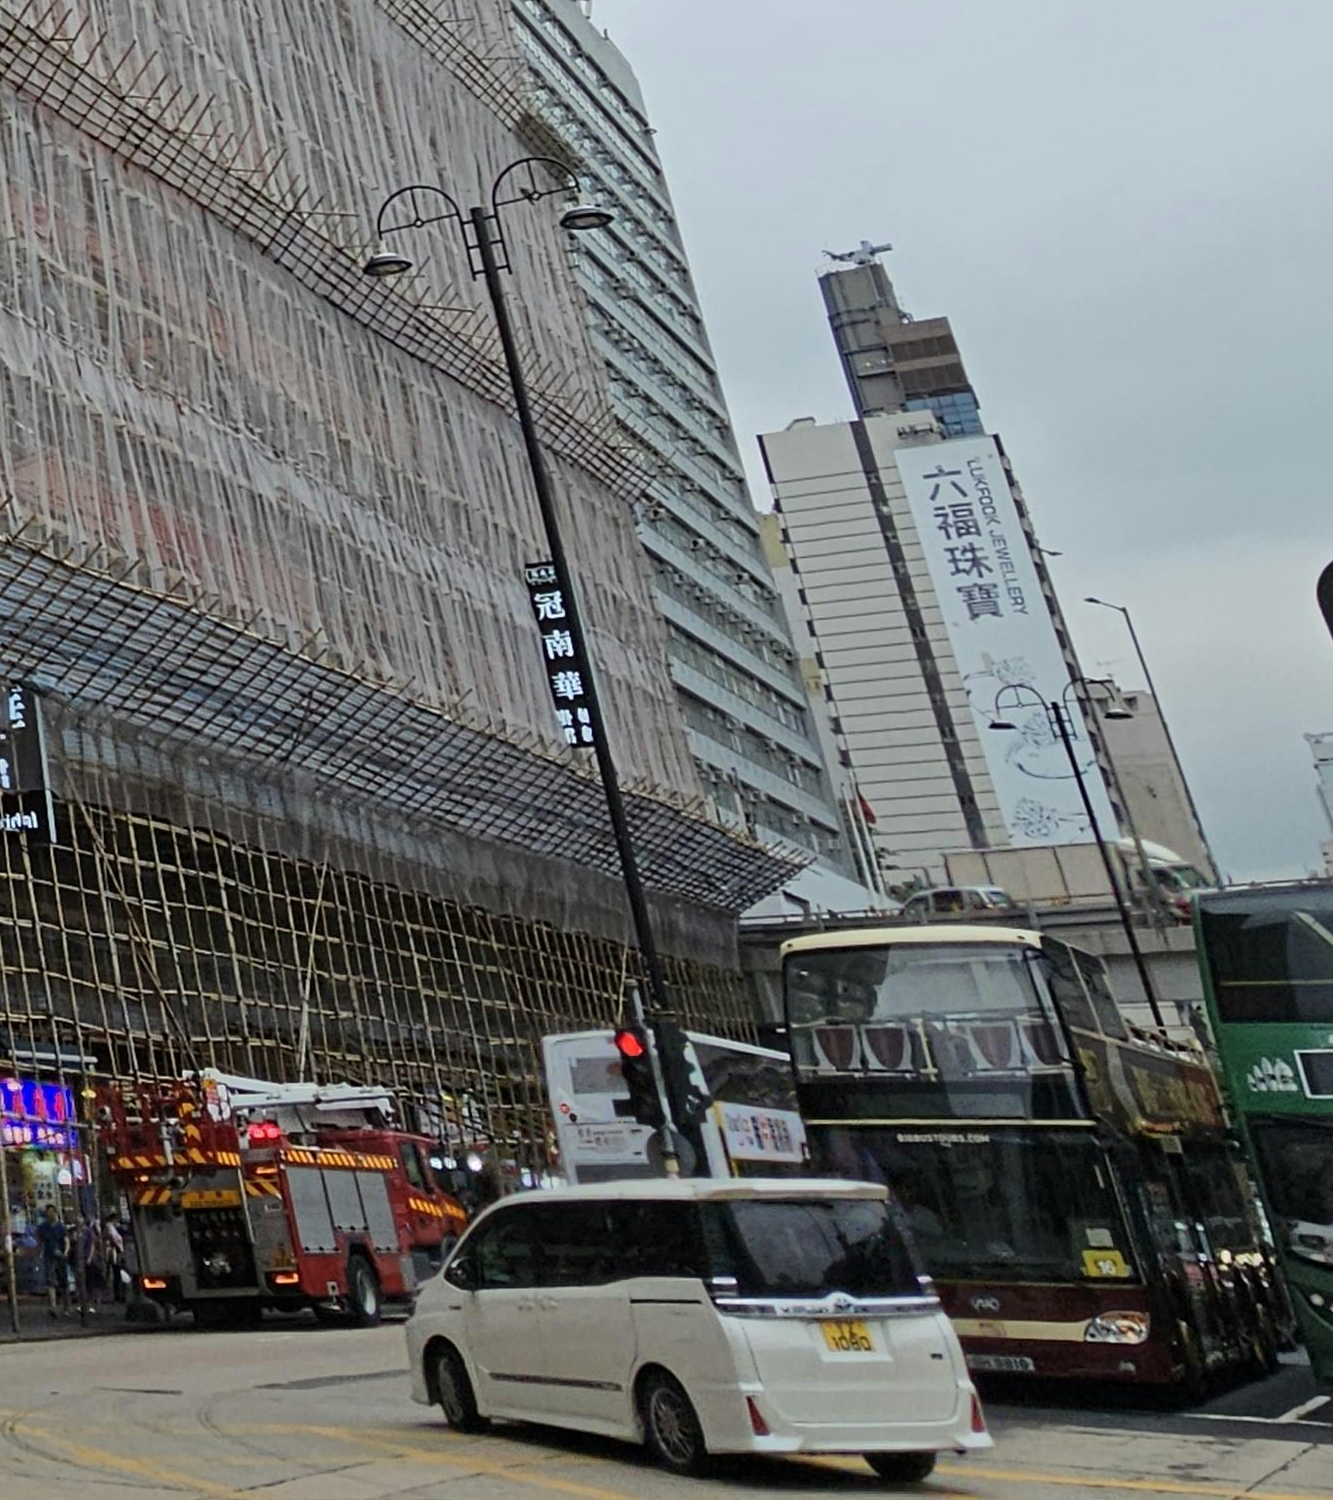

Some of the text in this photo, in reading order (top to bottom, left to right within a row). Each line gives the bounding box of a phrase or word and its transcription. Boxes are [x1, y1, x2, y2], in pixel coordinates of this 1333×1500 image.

[922, 464, 1004, 621] 六福珠寶
[967, 459, 1029, 615] LUKFOOK JEWELLERY
[534, 590, 584, 701] 冠南華
